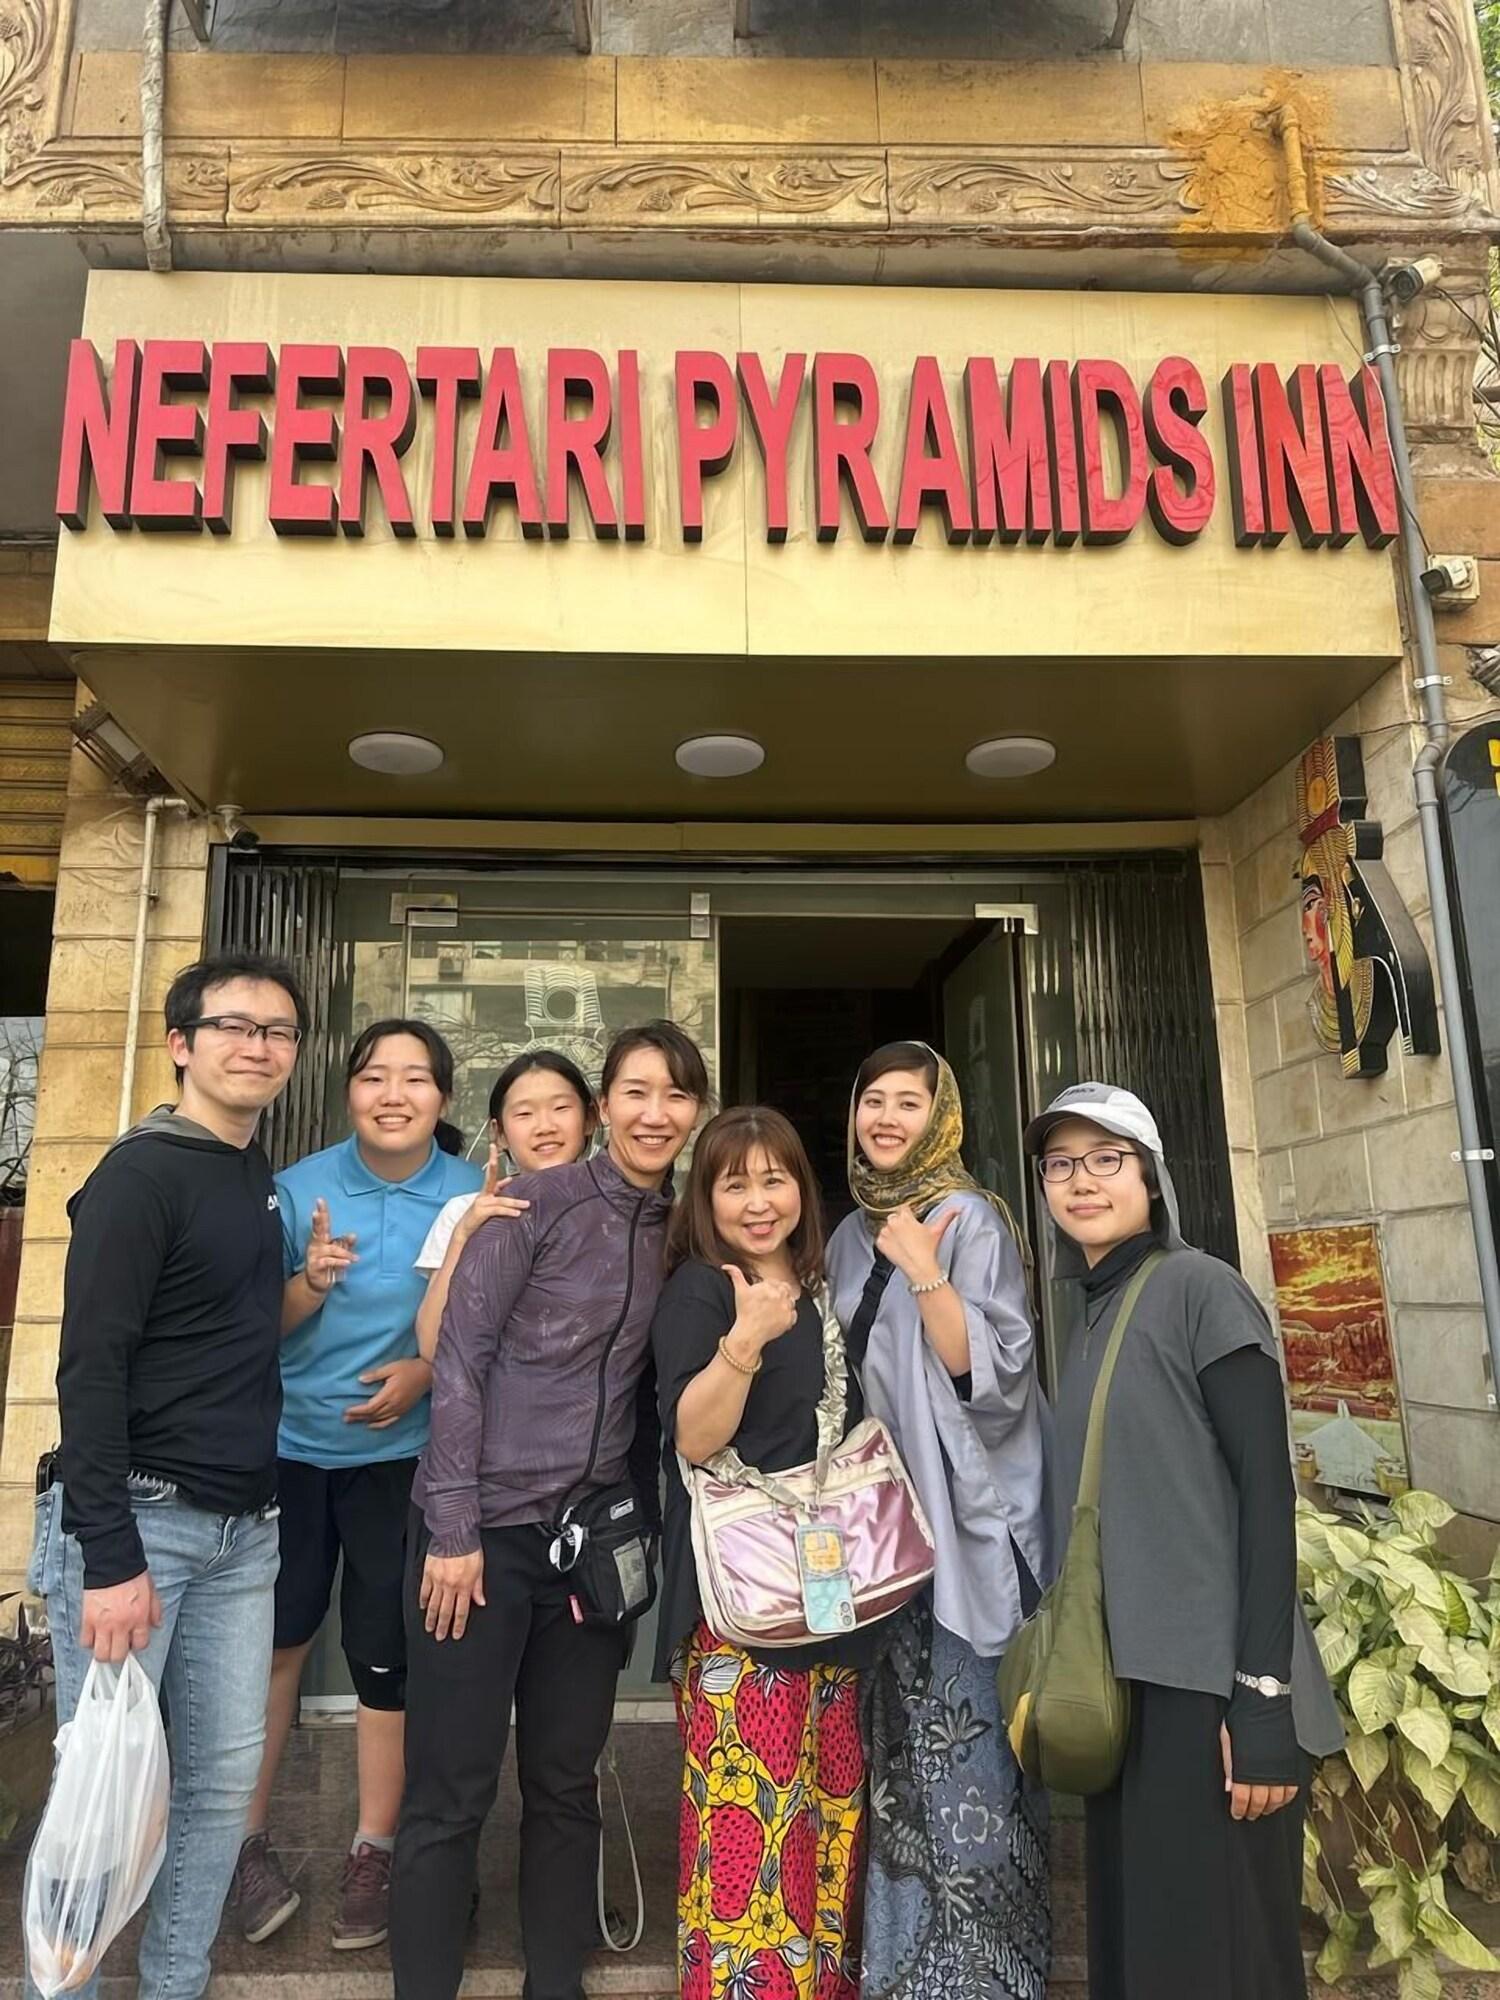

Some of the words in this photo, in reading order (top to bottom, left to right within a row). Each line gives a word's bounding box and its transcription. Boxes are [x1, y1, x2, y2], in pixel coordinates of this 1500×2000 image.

[55, 339, 646, 542] NEFERTARI
[674, 350, 1217, 547] PYRAMIDS
[1221, 363, 1400, 548] INN
